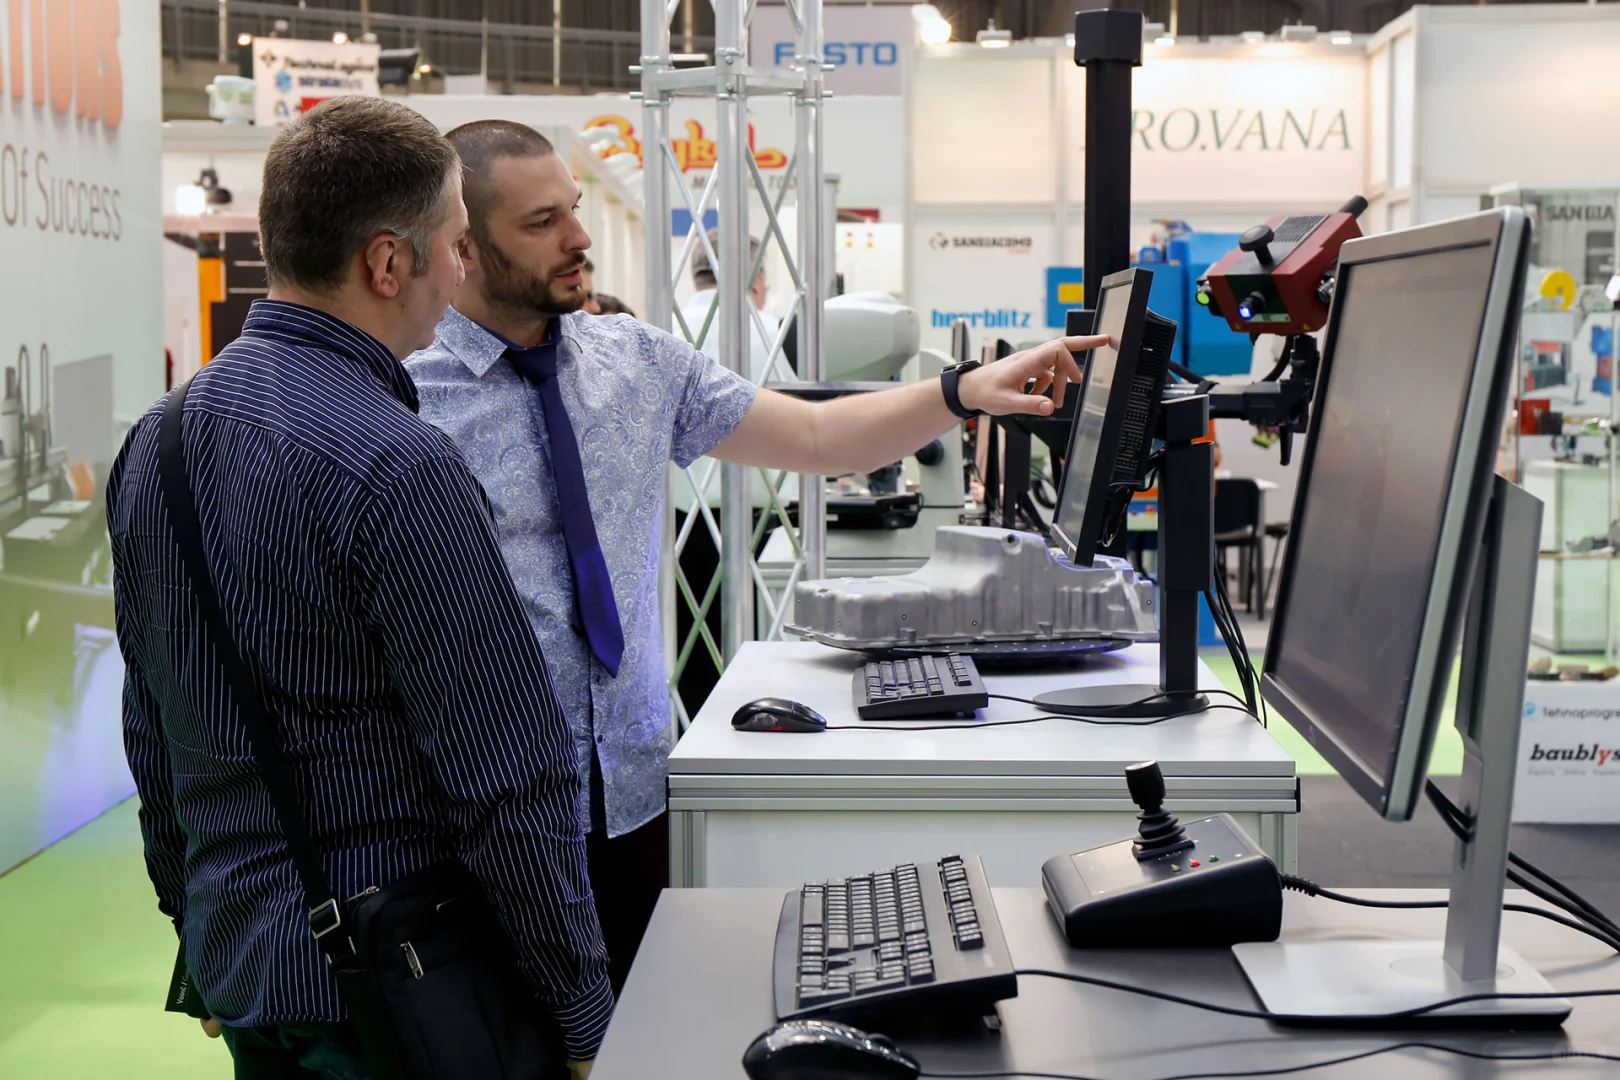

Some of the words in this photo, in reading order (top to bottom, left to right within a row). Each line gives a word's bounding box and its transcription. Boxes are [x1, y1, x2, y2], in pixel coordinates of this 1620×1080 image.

[774, 42, 898, 66] FSTO
[1, 143, 28, 227] Of
[35, 151, 123, 242] Success
